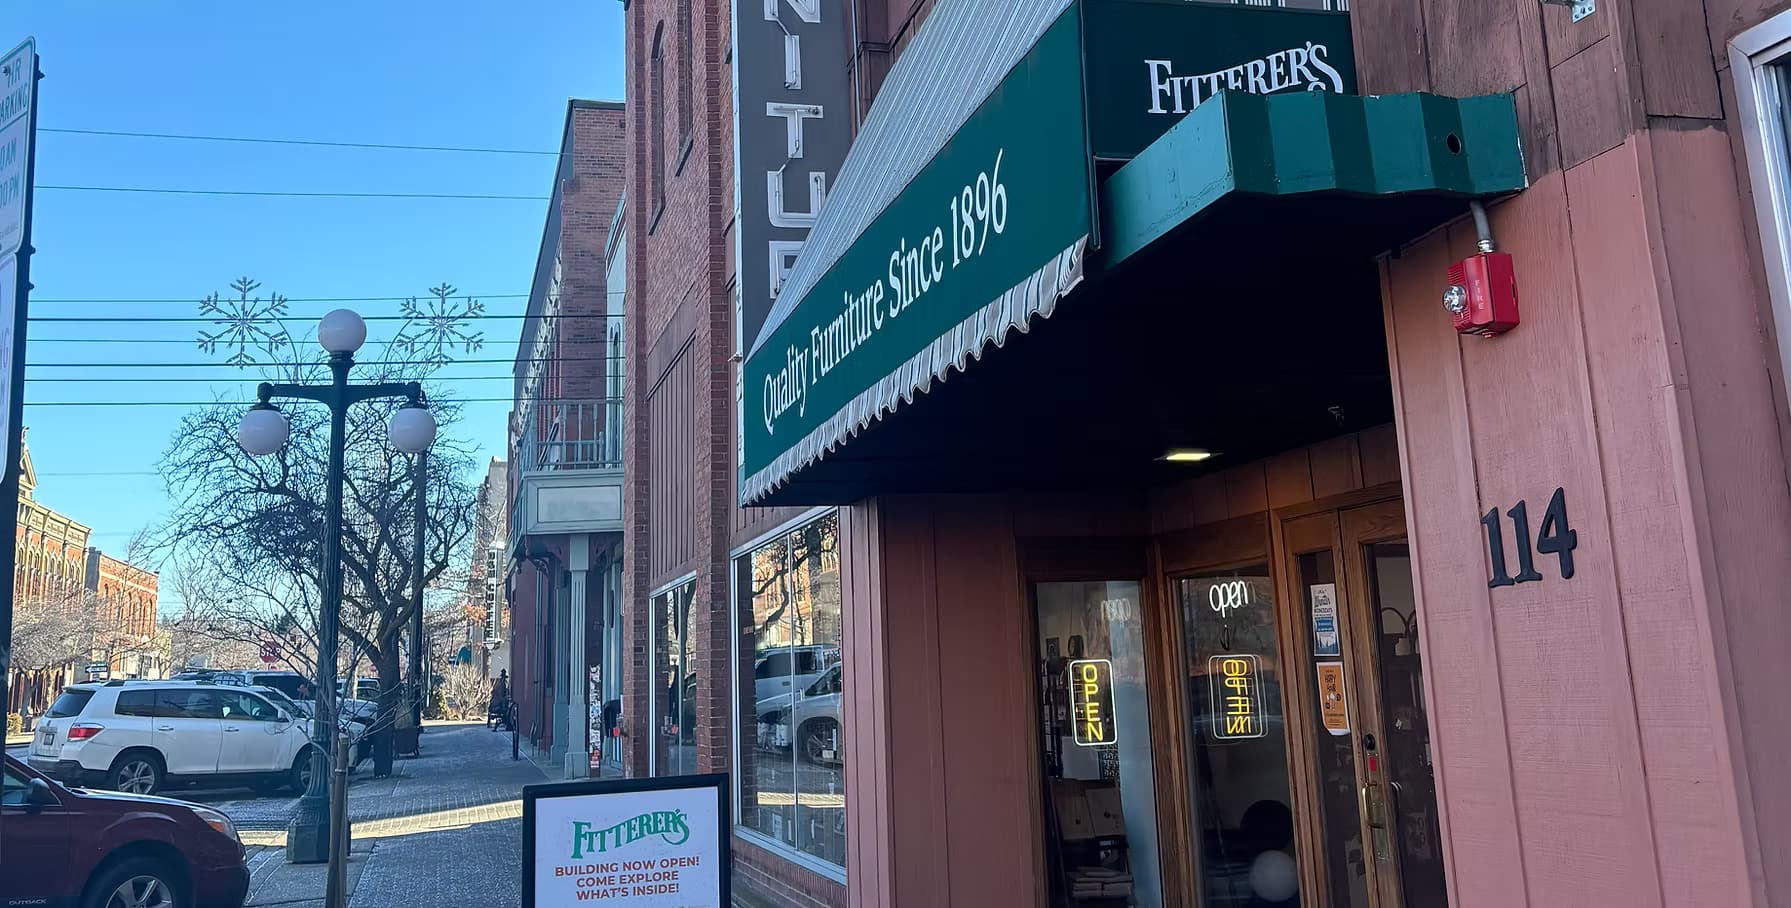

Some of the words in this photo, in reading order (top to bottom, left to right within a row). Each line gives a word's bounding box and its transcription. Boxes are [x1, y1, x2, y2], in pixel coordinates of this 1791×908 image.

[0, 81, 28, 121] ARKING
[763, 344, 809, 436] Quality
[811, 279, 884, 385] Furniture
[888, 226, 944, 318] Since
[950, 148, 1007, 269] 1896
[1480, 487, 1577, 588] 114
[1209, 580, 1249, 618] open
[1082, 664, 1104, 742] OPEN
[571, 808, 690, 859] FITTERER'S
[555, 862, 619, 877] BUILDING
[622, 859, 656, 872] NOW
[659, 856, 700, 869] OPEN!
[576, 875, 615, 888] COME
[619, 870, 679, 885] EXPLORE
[576, 886, 629, 901] WHAT'S
[632, 883, 680, 897] INSIDE!
